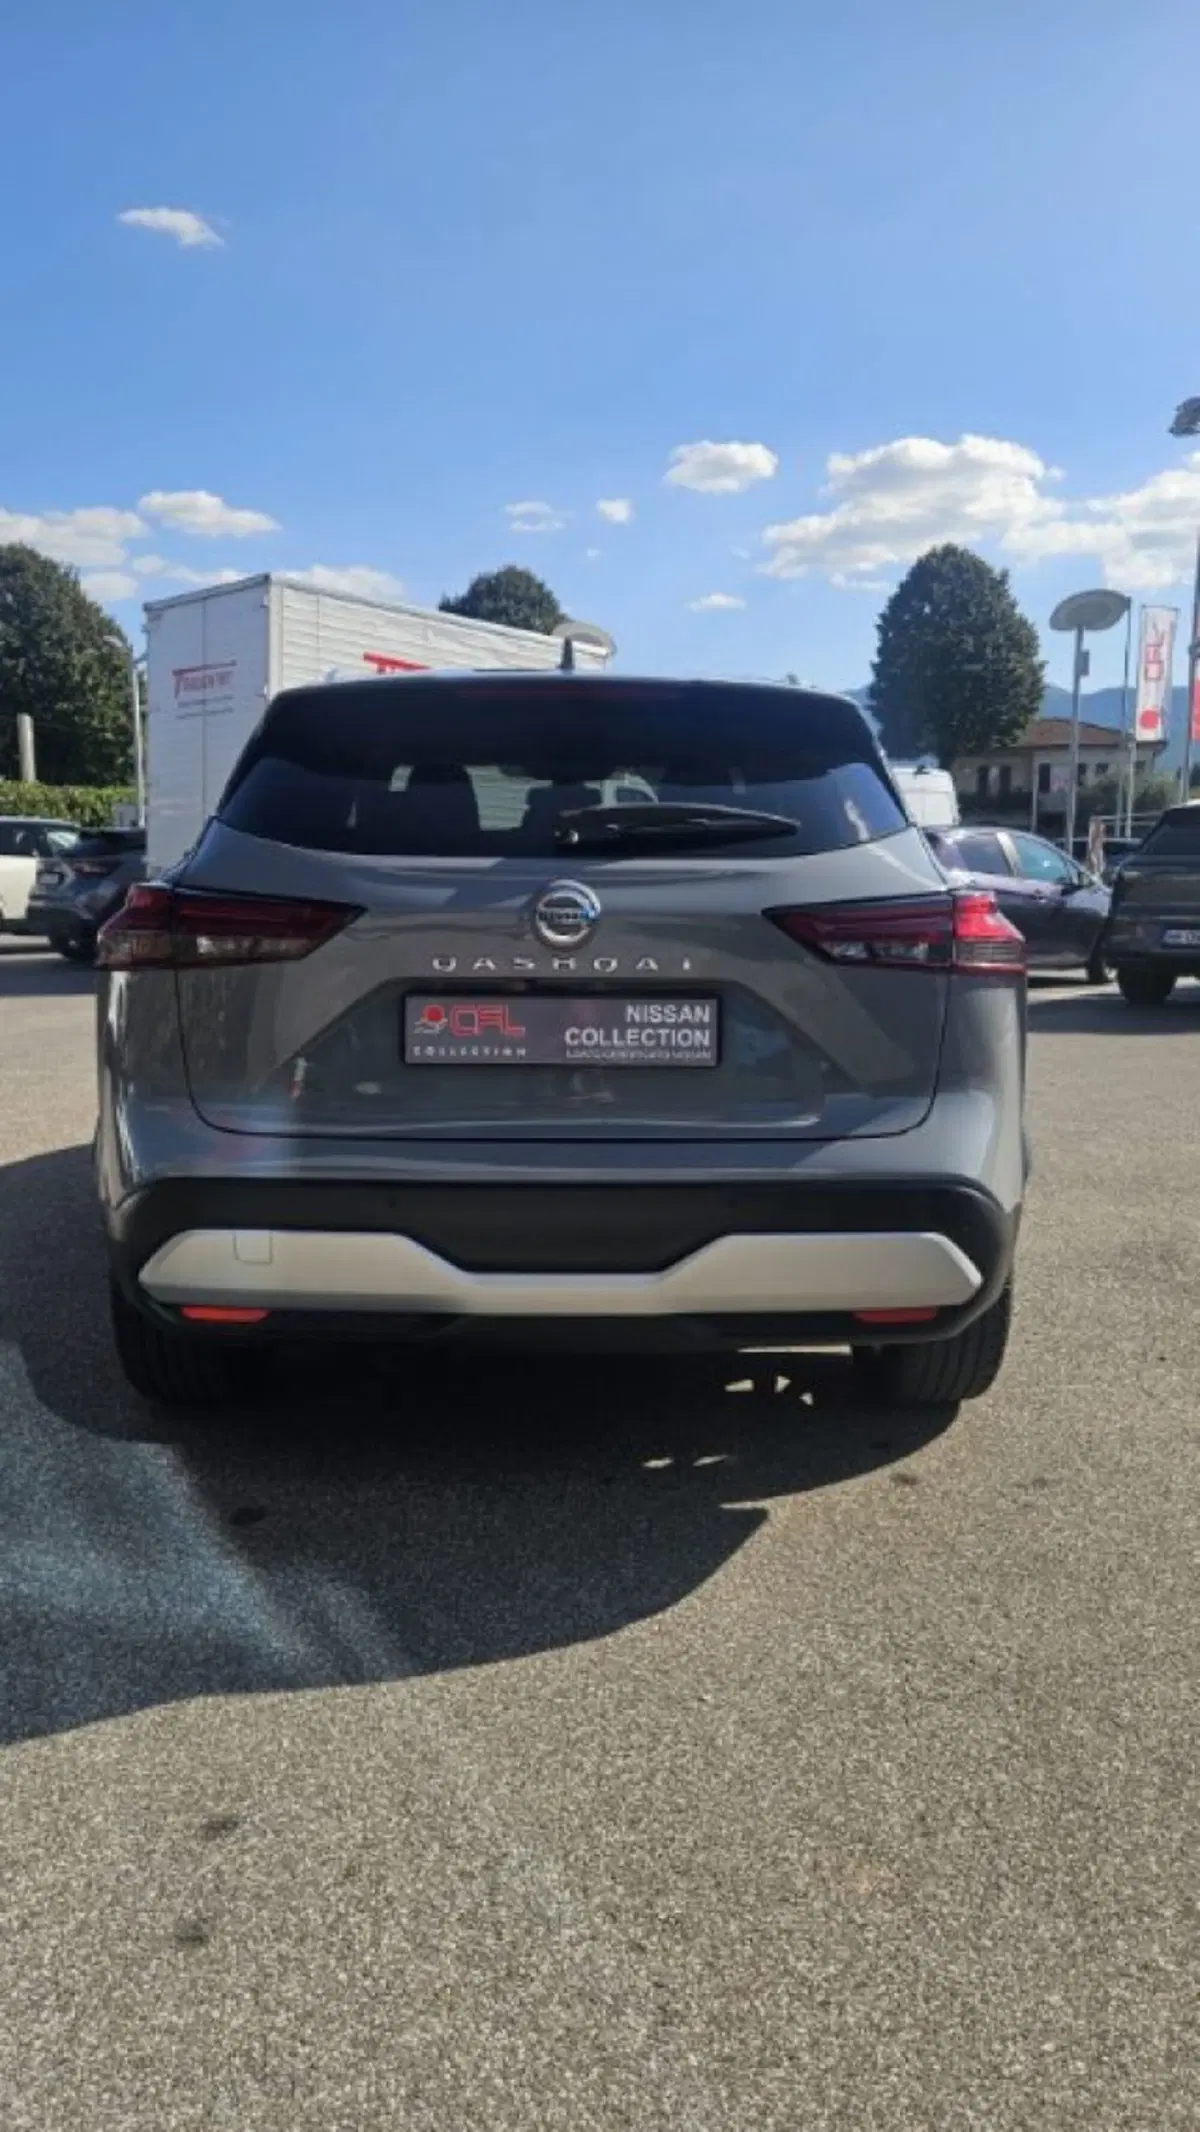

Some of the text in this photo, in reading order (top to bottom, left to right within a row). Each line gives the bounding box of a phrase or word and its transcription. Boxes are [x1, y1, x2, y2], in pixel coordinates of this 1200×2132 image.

[432, 956, 692, 973] QASHQAI
[625, 1004, 710, 1023] NISSAN
[564, 1027, 711, 1047] COLLECTION
